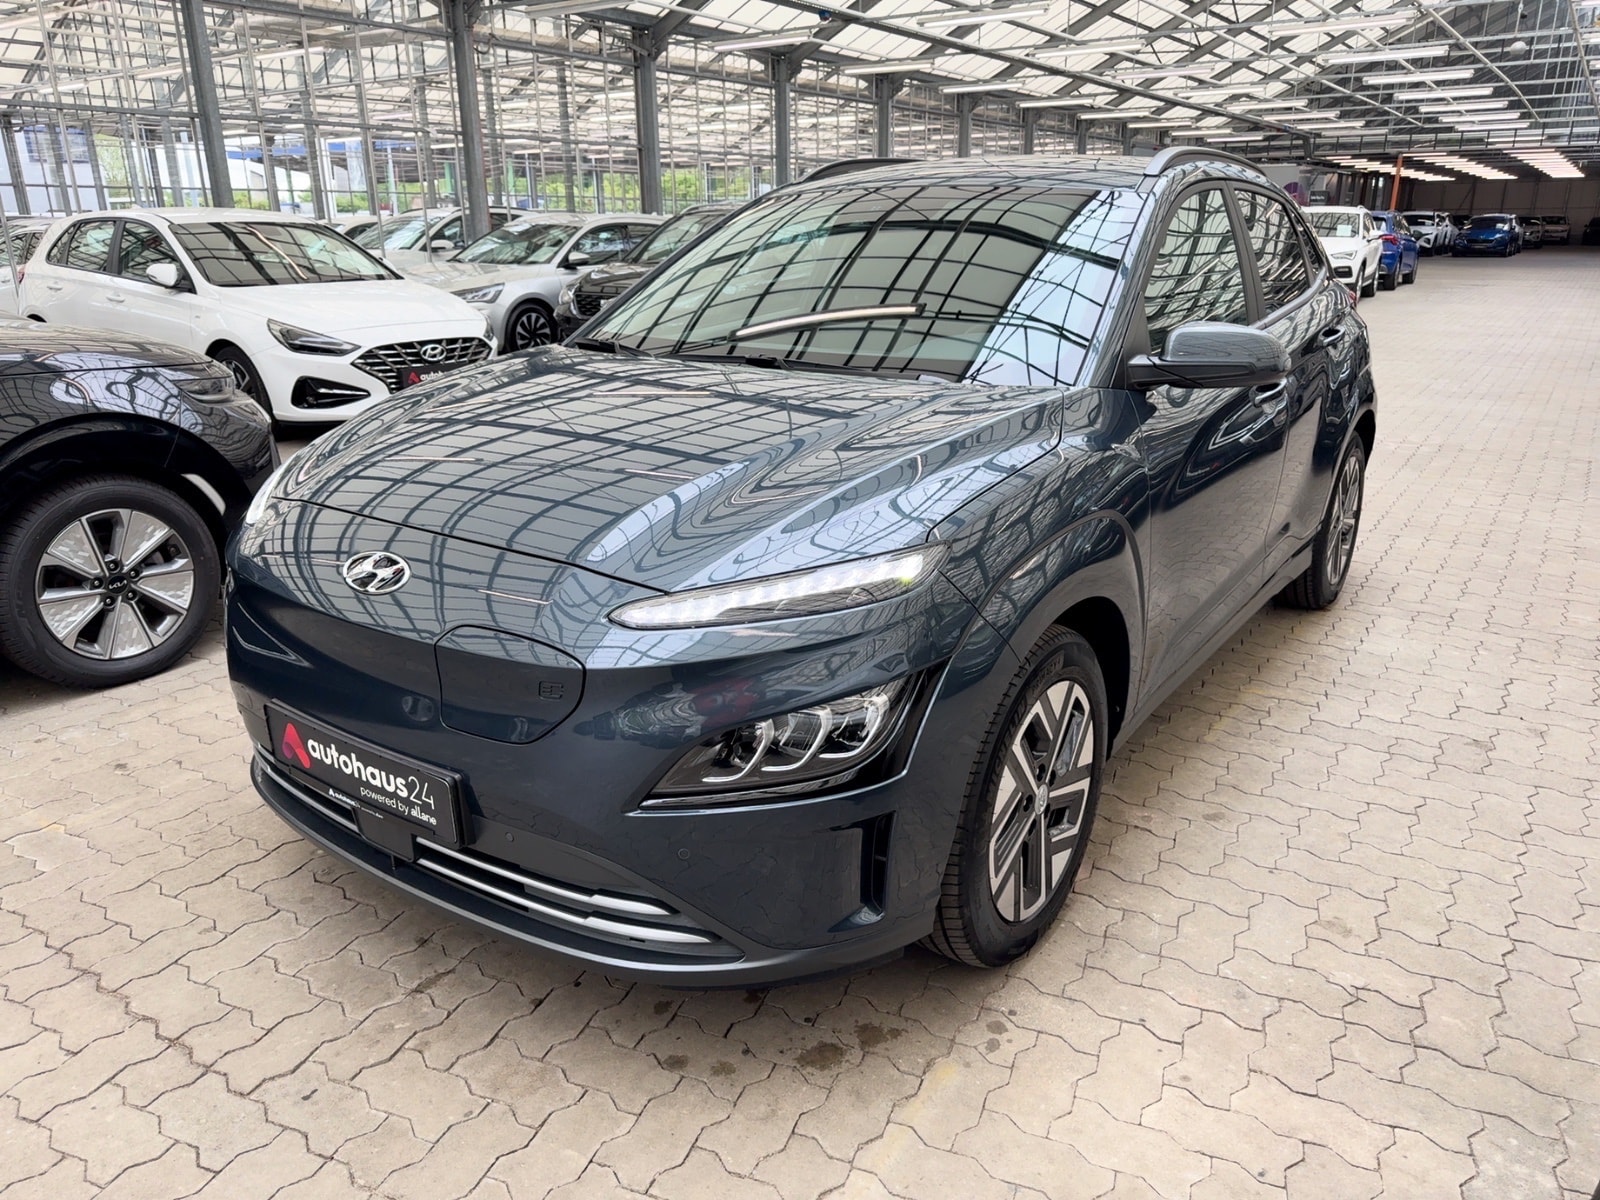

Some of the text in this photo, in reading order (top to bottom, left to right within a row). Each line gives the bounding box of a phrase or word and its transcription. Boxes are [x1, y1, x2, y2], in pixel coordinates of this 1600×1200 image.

[307, 738, 435, 810] autohaus24
[360, 786, 397, 808] powered
[397, 801, 409, 815] by
[410, 805, 437, 826] allane
